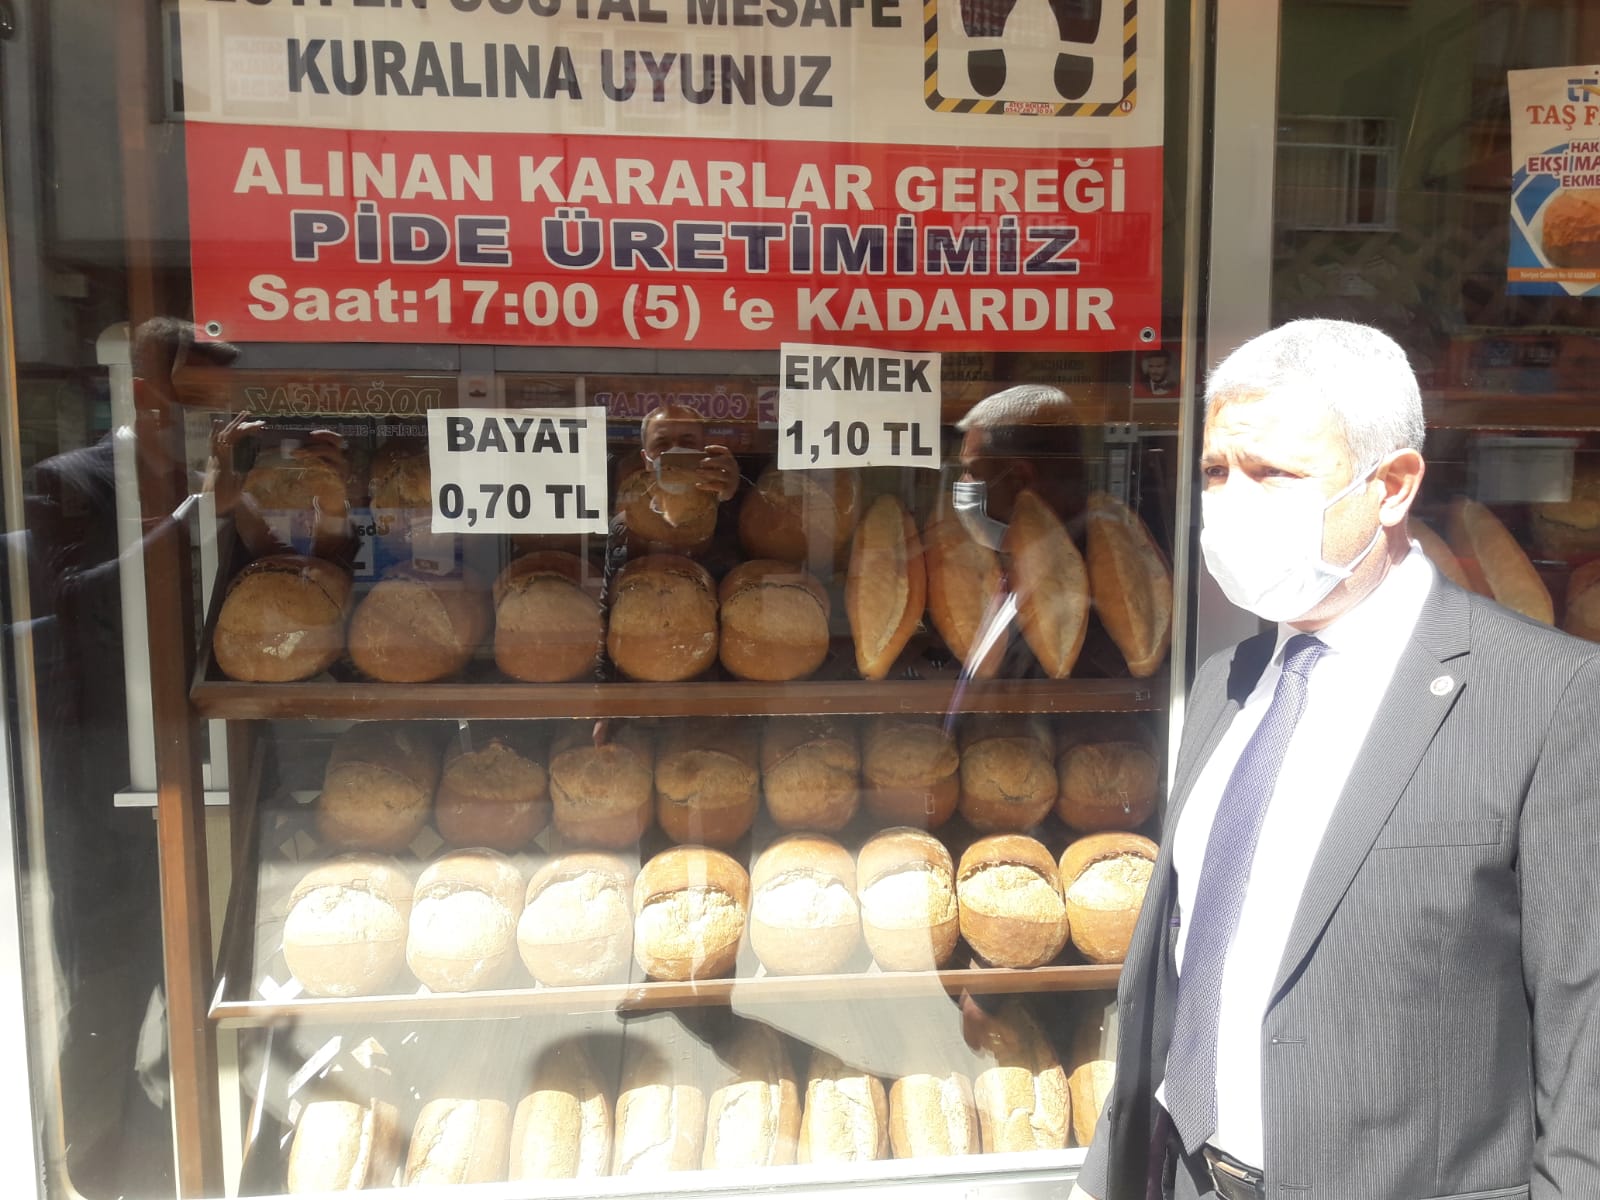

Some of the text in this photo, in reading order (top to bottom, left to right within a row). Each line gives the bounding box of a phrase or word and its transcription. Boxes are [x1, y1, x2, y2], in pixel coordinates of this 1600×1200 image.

[287, 38, 583, 100] KURALINA
[601, 49, 833, 108] UYUNUZ
[1526, 104, 1600, 131] TAŞ F
[233, 147, 1125, 213] ALINAN KARARLAR GEREĞİ
[1528, 152, 1569, 176] EKŞİ
[290, 200, 1080, 275] PİDE ÜRETİMİMİZ
[248, 274, 598, 327] Saat:17:00
[622, 283, 700, 341] (5)
[797, 287, 1116, 331] KADARDIR
[785, 355, 932, 393] EKMEK
[446, 416, 588, 454] BAYAT
[786, 421, 933, 464] 1,10 TL
[438, 482, 532, 528] 0,70
[546, 484, 600, 520] TL
